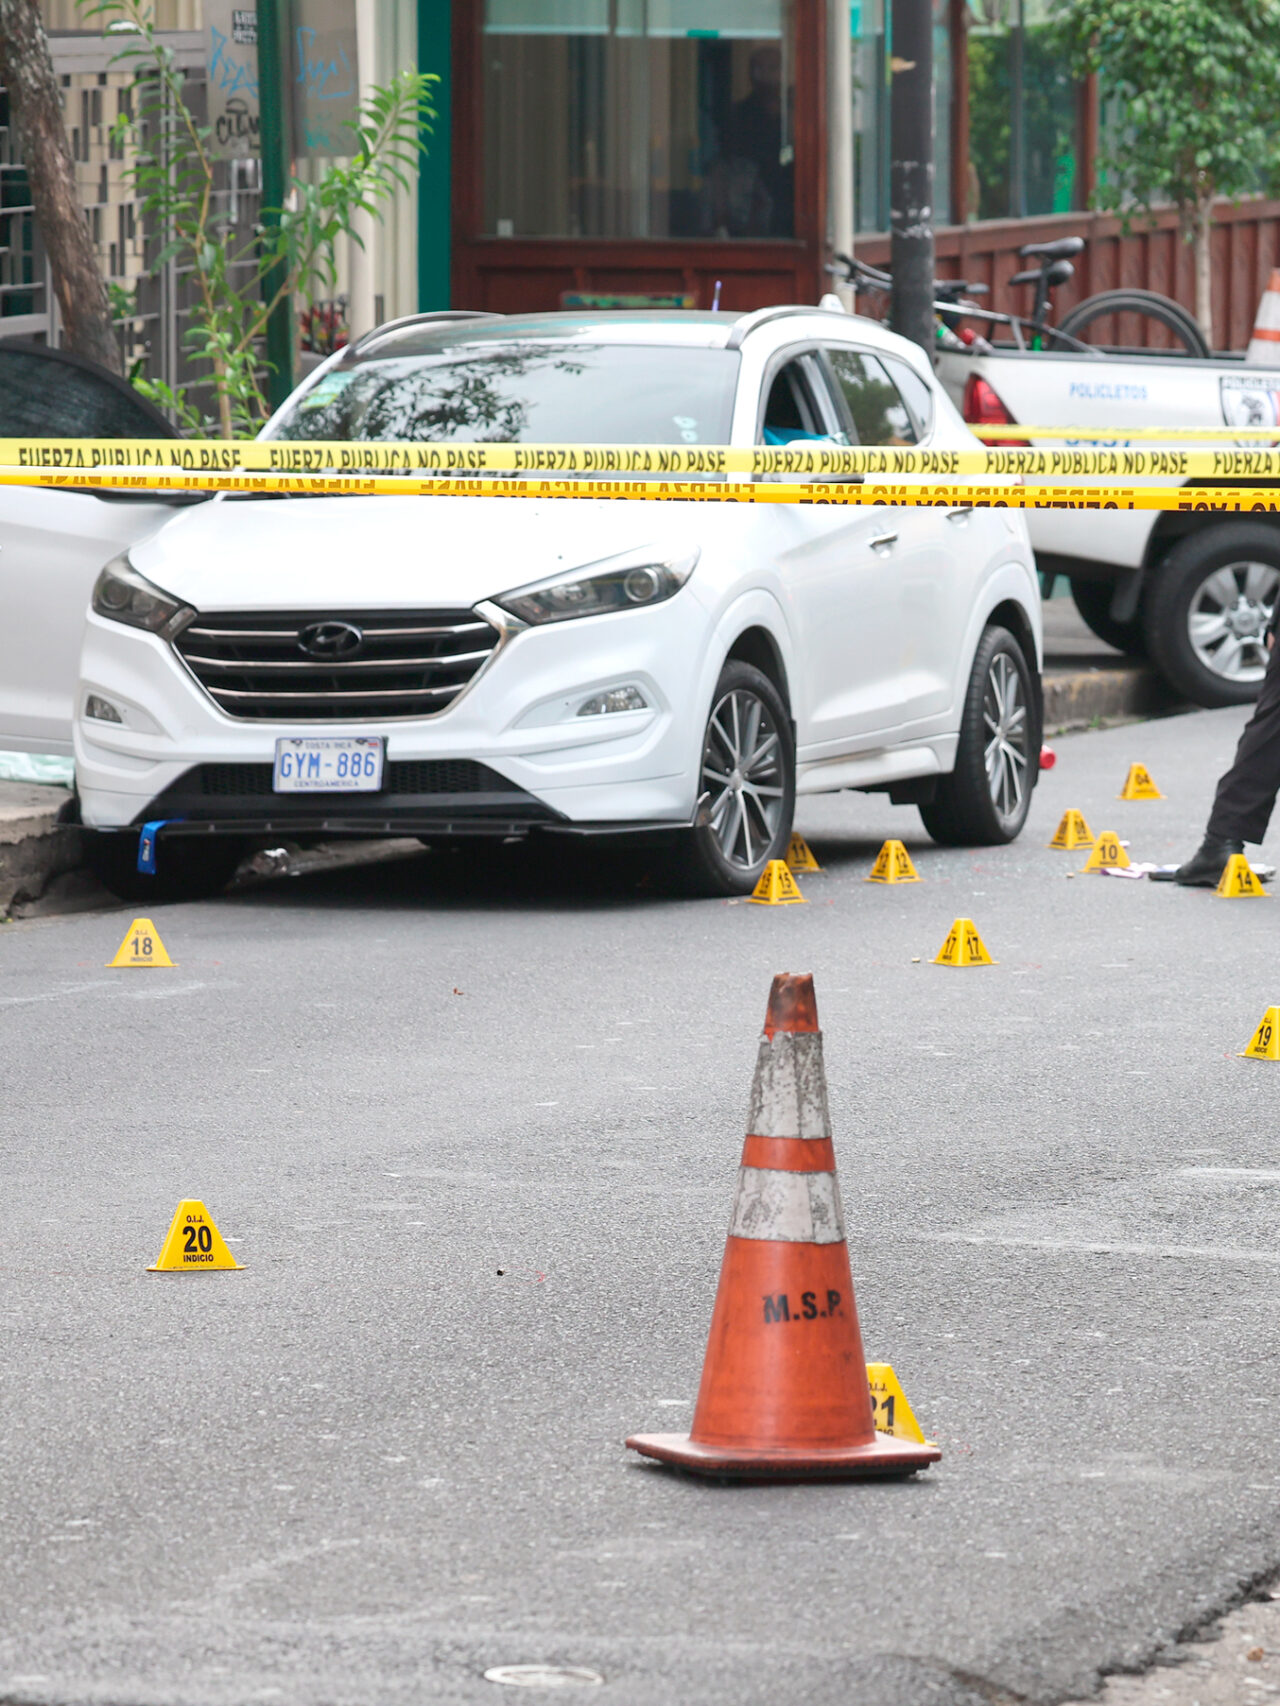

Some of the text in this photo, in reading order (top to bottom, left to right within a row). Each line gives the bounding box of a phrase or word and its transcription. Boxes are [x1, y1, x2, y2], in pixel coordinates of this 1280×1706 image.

[1069, 382, 1147, 400] POLICLETOS
[752, 450, 959, 474] FUERZA PUBLICA NO PASE
[985, 451, 1188, 475] FUERZA PUBLICA NO PASE
[1213, 451, 1273, 475] FUERZA
[281, 752, 376, 778] GYM-886
[1099, 844, 1118, 860] 10
[1237, 871, 1252, 888] 14
[131, 937, 153, 956] 18
[1258, 1025, 1272, 1047] 19
[182, 1225, 213, 1253] 20
[183, 1254, 214, 1263] INDICIO
